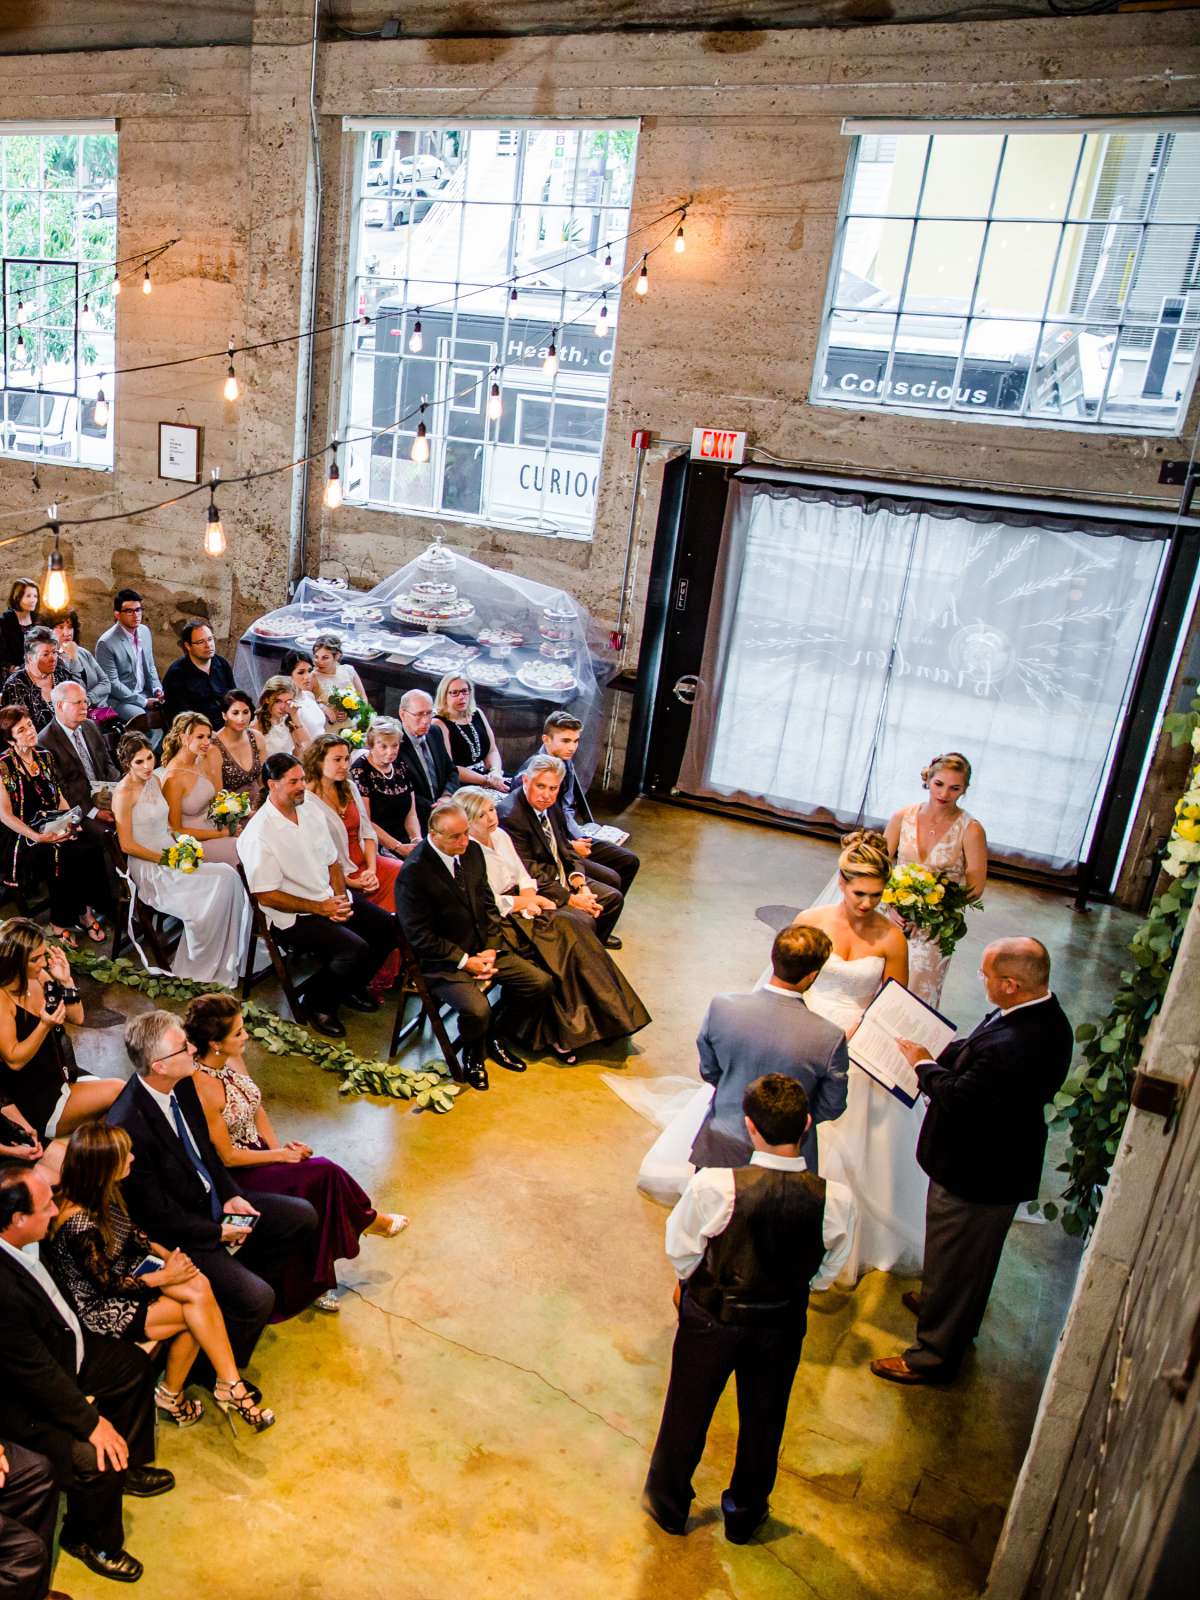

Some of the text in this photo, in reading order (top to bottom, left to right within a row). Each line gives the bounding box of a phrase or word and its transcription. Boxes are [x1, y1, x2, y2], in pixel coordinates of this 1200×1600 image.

[507, 340, 588, 366] Heath,
[840, 373, 988, 404] Conscious
[700, 431, 737, 459] EXIT
[678, 581, 687, 607] PULL
